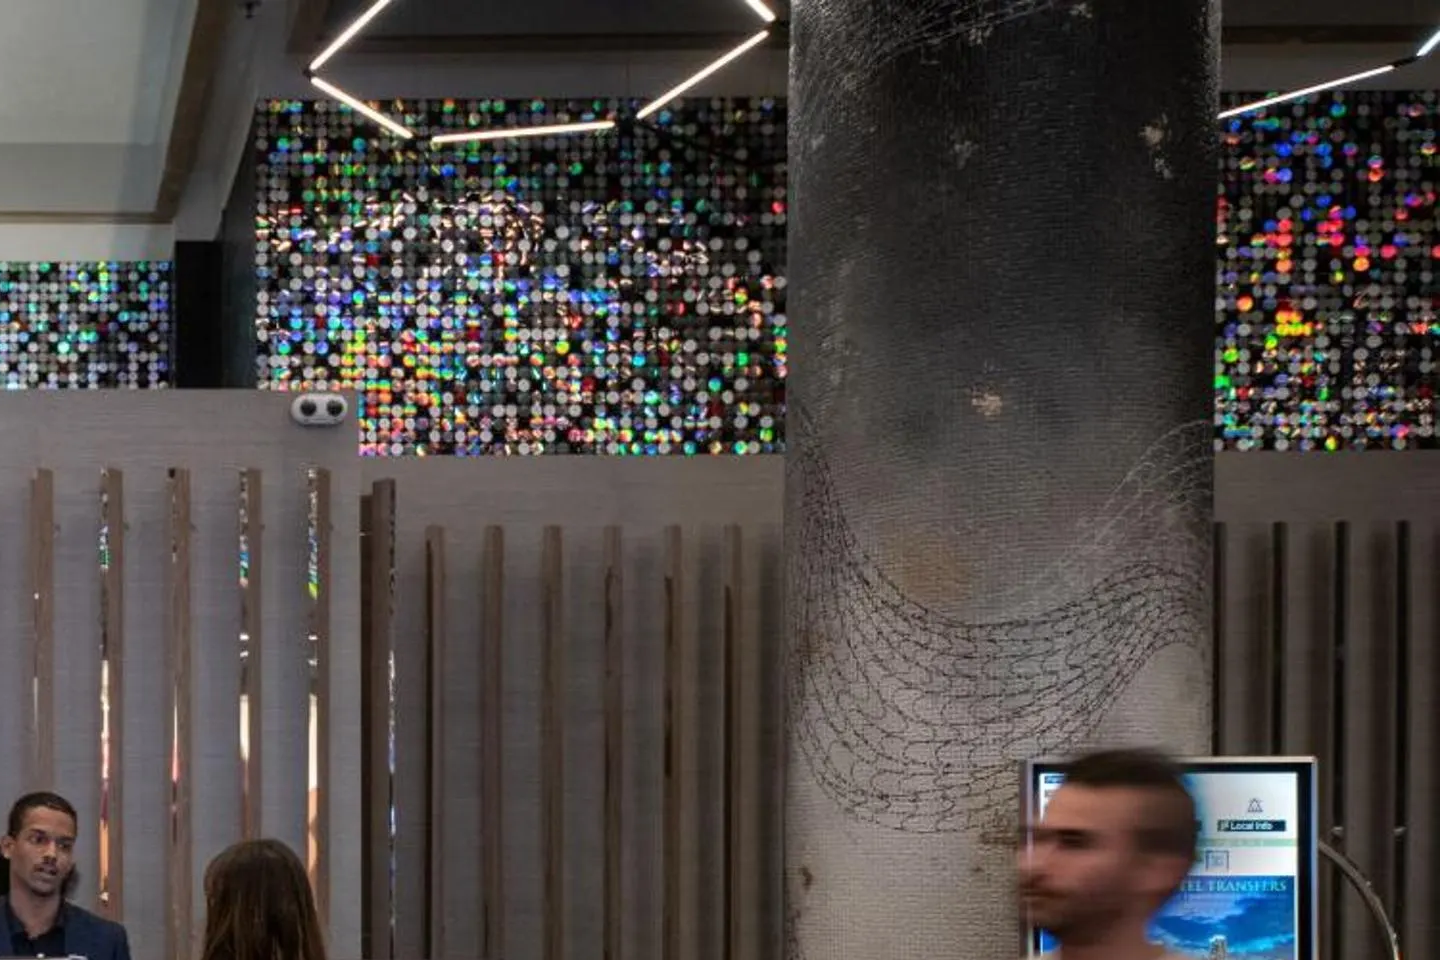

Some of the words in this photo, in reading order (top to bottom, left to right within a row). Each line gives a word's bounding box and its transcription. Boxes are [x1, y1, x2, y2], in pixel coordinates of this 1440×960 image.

[1230, 821, 1254, 831] Local
[1255, 821, 1273, 831] Info
[1208, 879, 1287, 892] TRANSFERS
